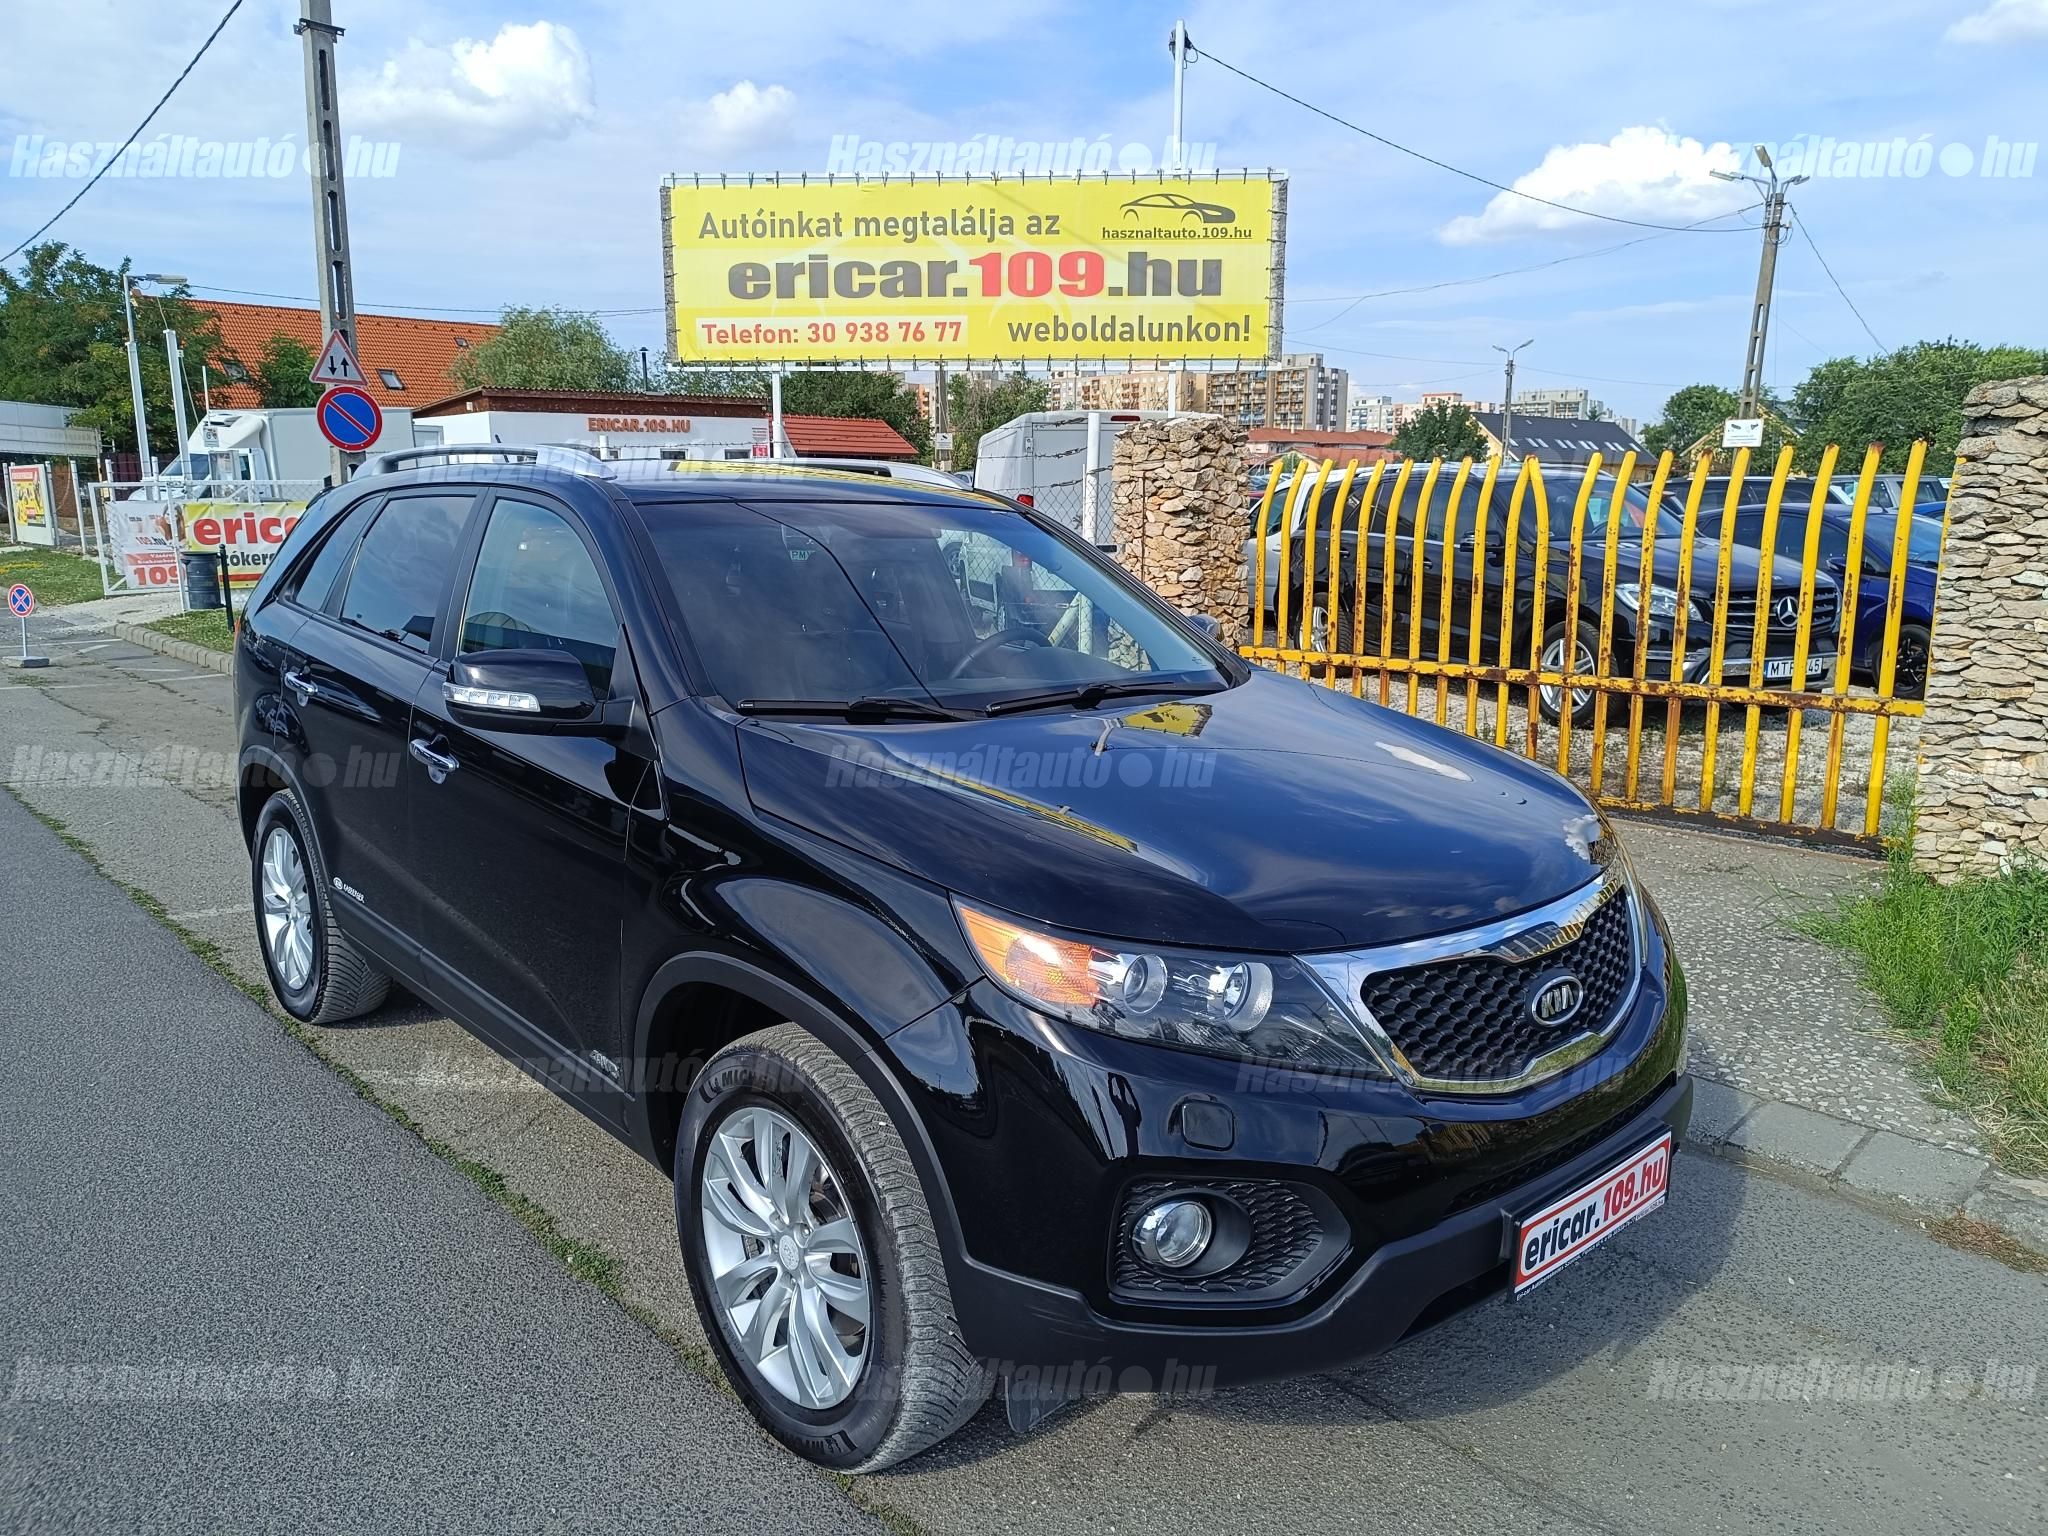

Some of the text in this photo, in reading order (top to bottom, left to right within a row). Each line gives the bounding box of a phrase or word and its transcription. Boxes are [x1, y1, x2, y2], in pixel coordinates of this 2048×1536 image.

[699, 205, 1060, 243] Autóinkat megtalálja az
[1102, 227, 1252, 239] hasznaltauto.109.hu
[728, 251, 1222, 299] ericar.109.hu
[702, 321, 961, 343] Telefon: 30 938 76 77
[1008, 315, 1250, 342] weboldalunkon!
[588, 417, 691, 433] ERICAR.109.HU
